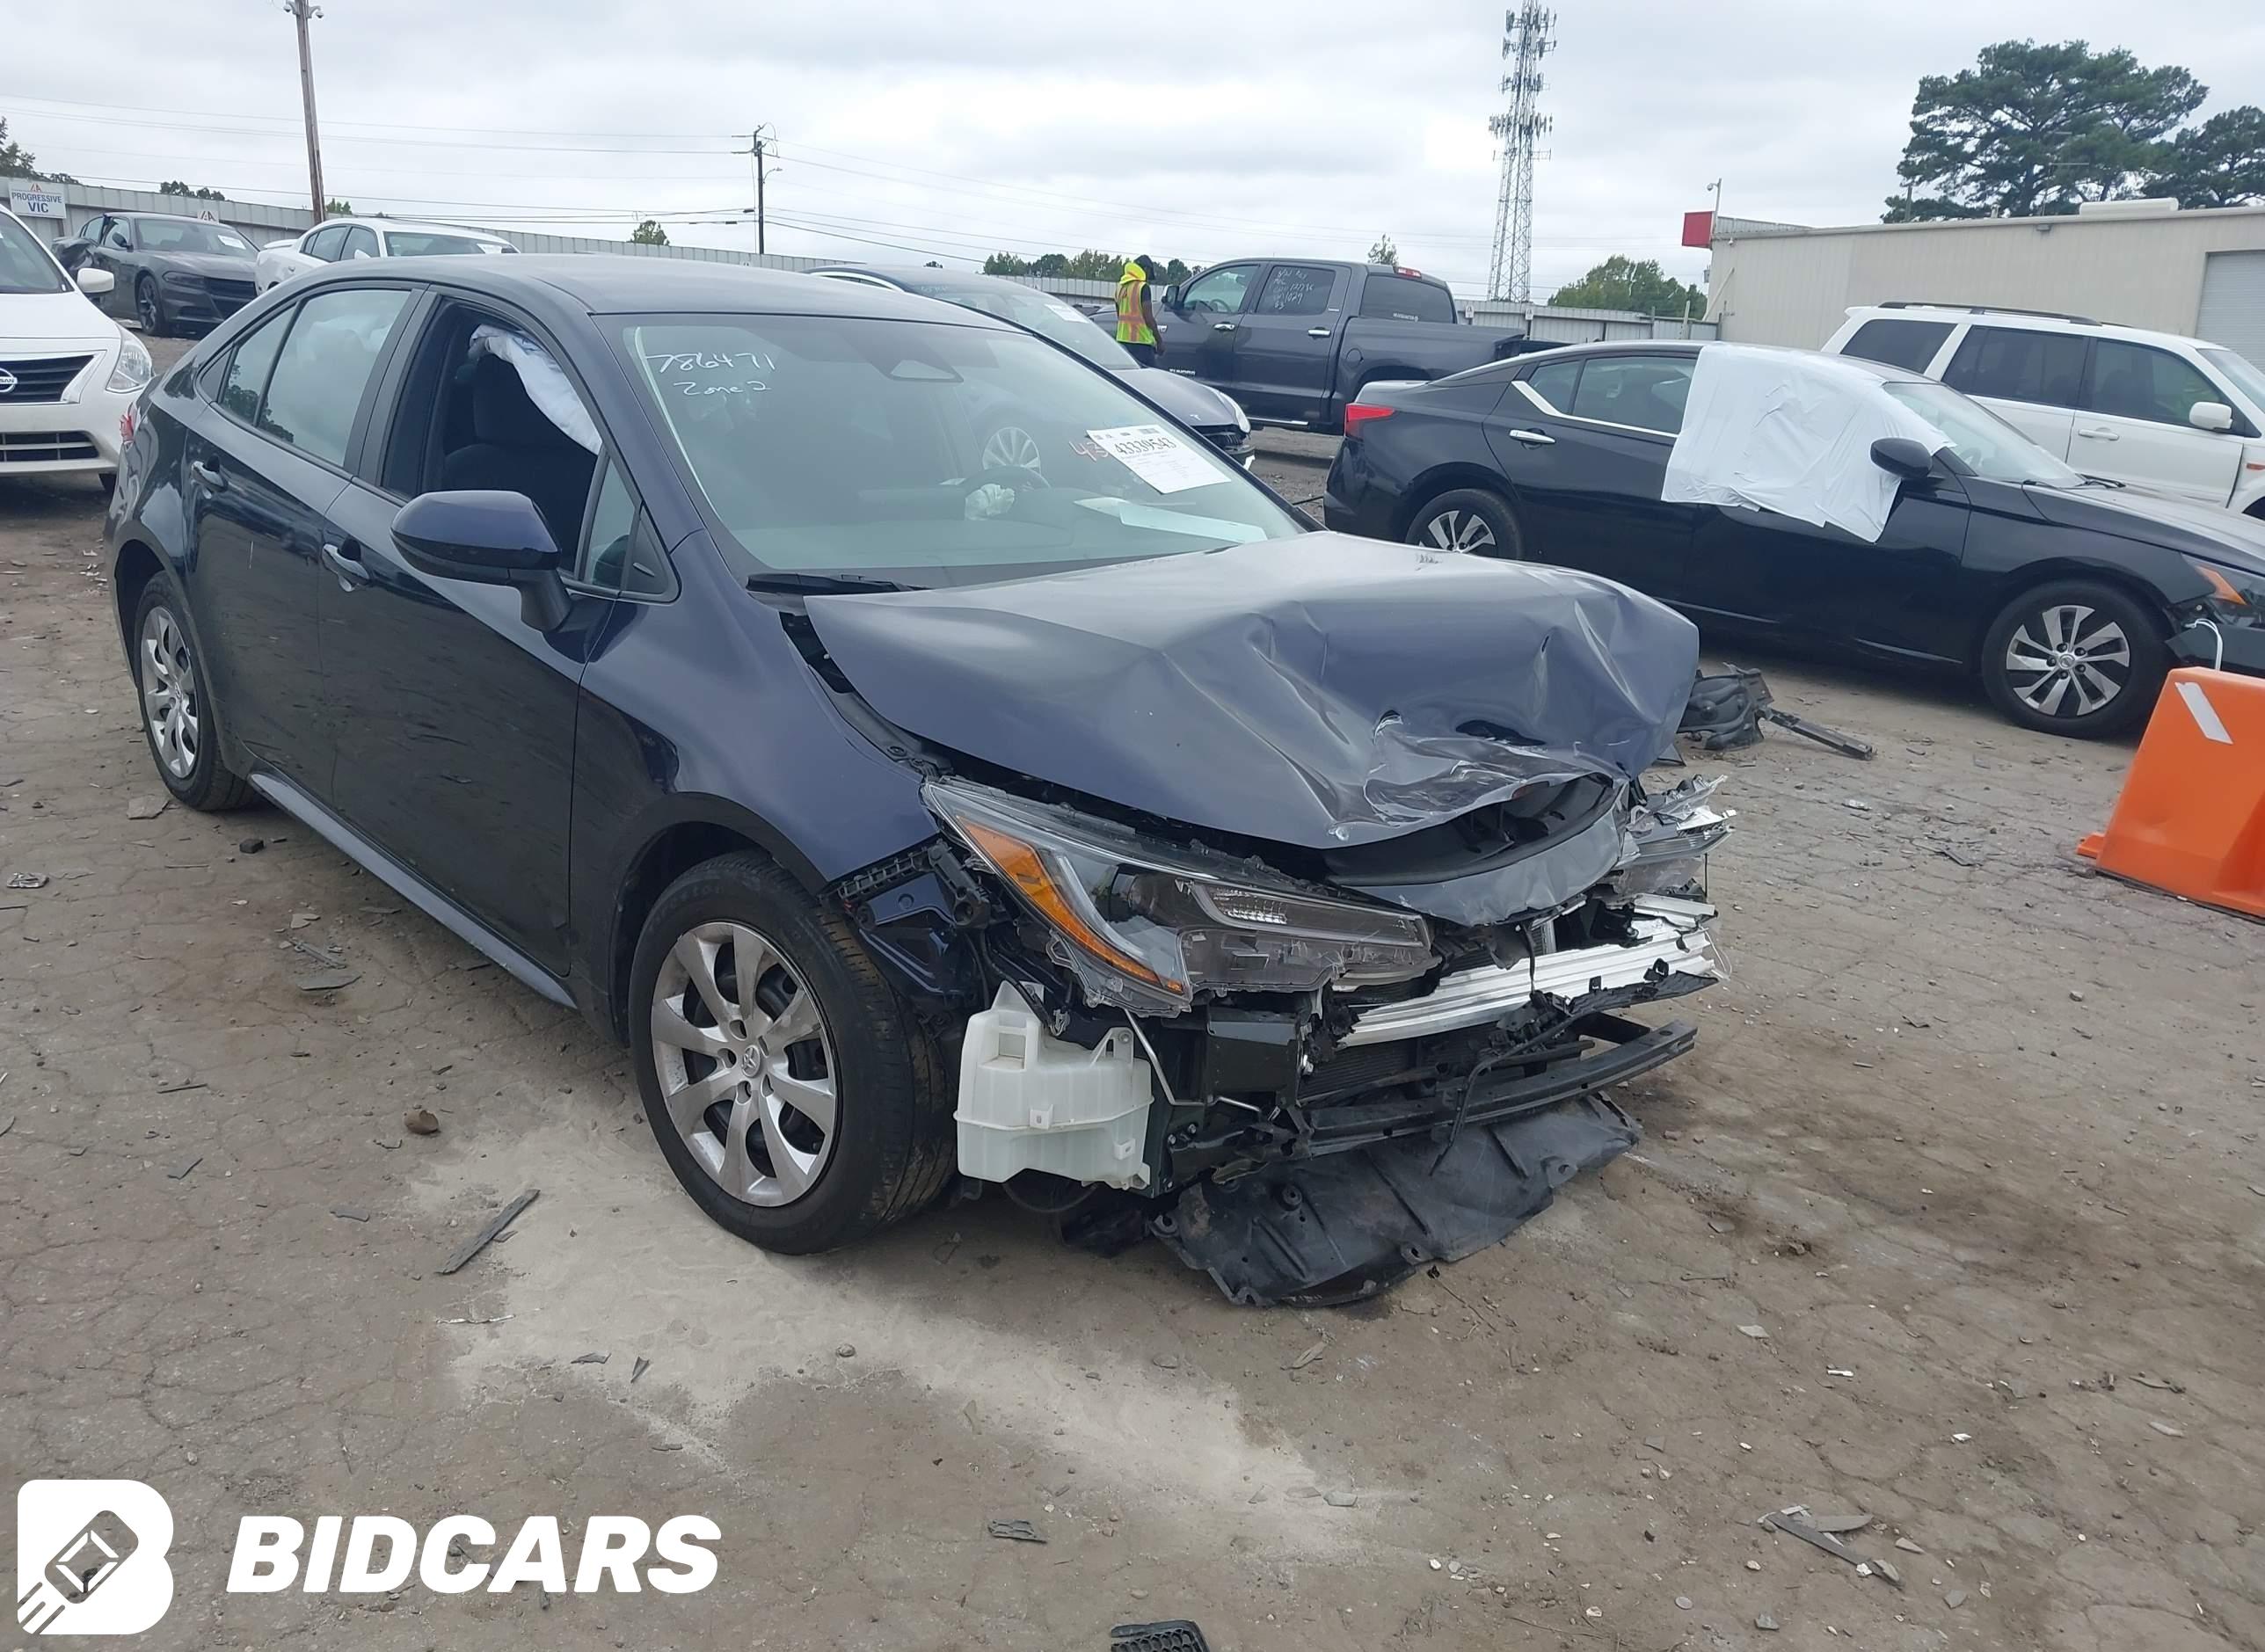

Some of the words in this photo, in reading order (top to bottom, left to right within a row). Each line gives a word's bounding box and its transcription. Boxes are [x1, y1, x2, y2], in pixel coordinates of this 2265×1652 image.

[11, 192, 62, 204] PROGRESSIVE
[28, 201, 48, 213] VIC
[646, 352, 776, 373] 786471
[1114, 437, 1177, 455] 43339543
